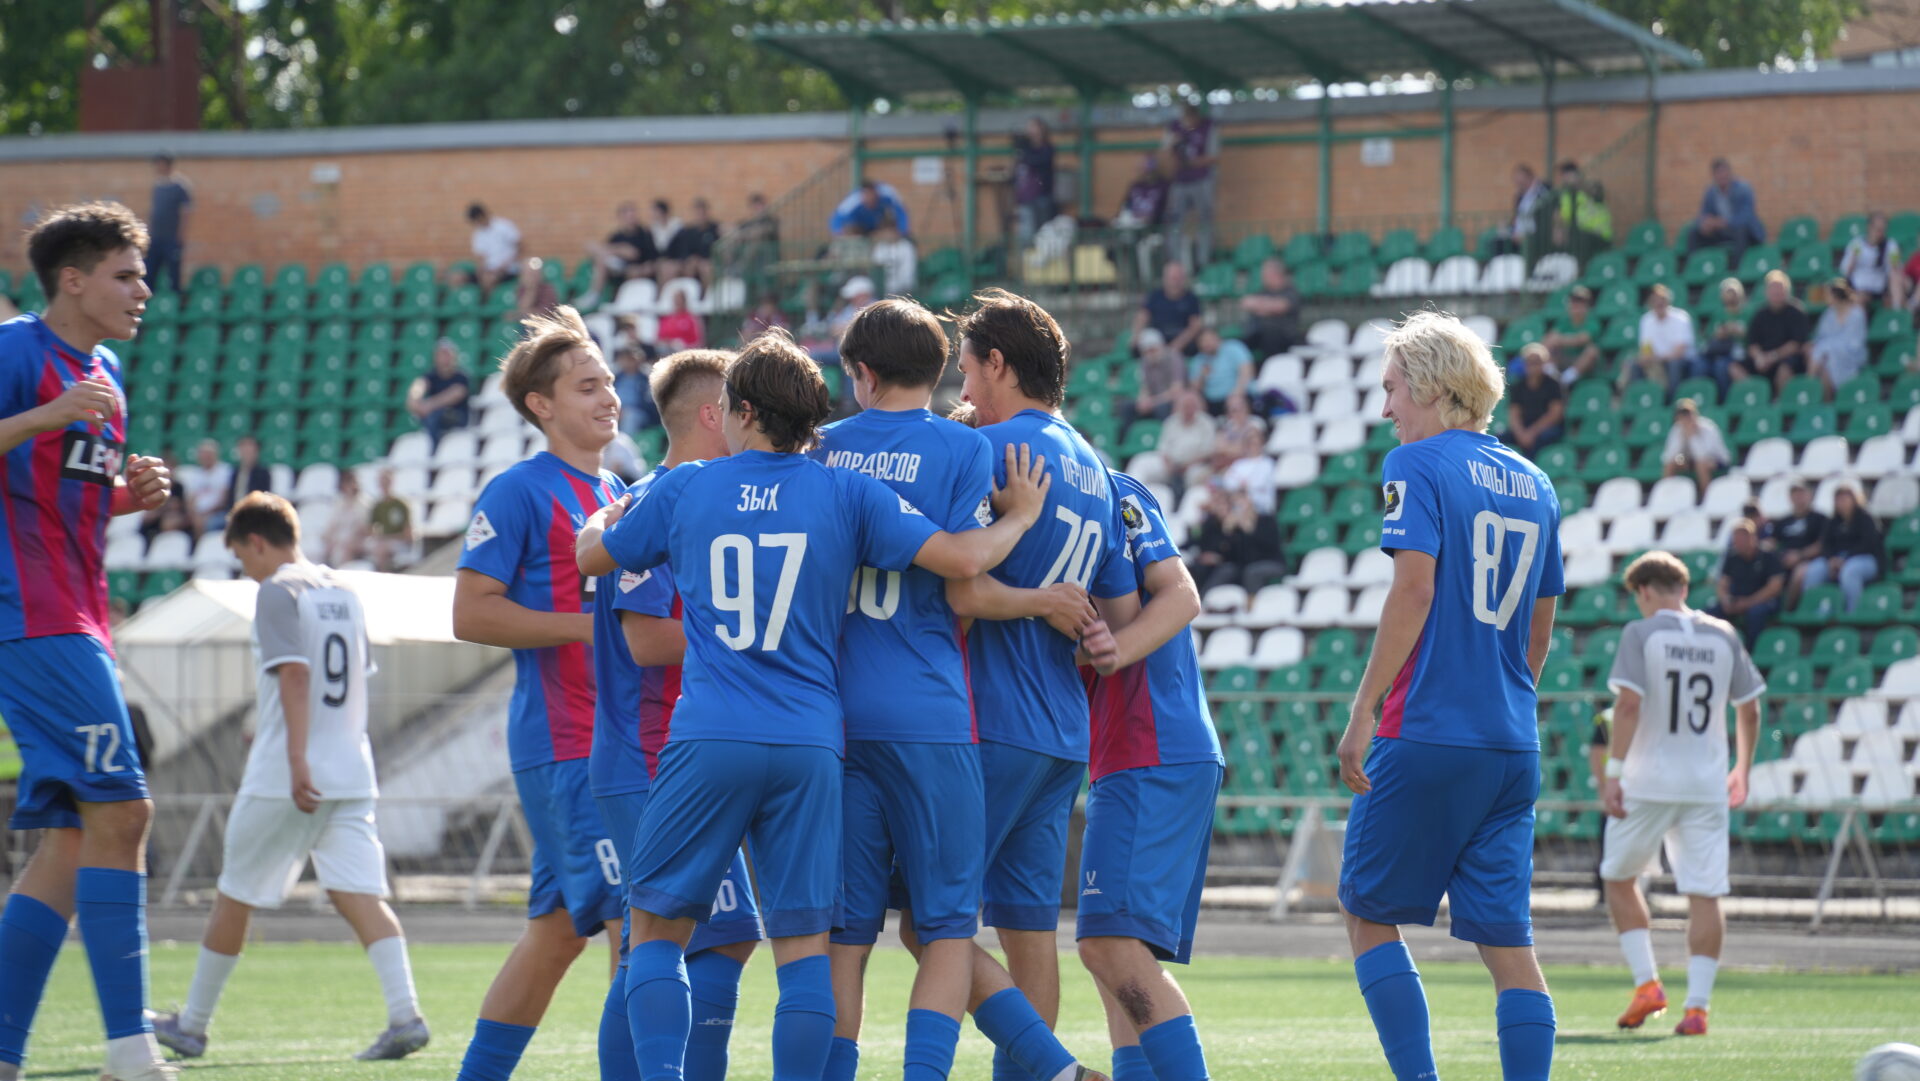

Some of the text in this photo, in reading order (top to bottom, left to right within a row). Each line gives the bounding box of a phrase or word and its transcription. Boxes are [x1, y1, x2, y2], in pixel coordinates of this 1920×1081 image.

[737, 483, 779, 511] ЗЫХ
[825, 450, 921, 483] МОРДАСОВ
[1467, 460, 1538, 501] КОПЫЛОВ
[1039, 505, 1102, 592] 70
[1473, 510, 1540, 631] 87
[710, 533, 807, 651] 97
[322, 632, 348, 707] 9
[1665, 669, 1713, 735] 13
[75, 723, 124, 772] 72
